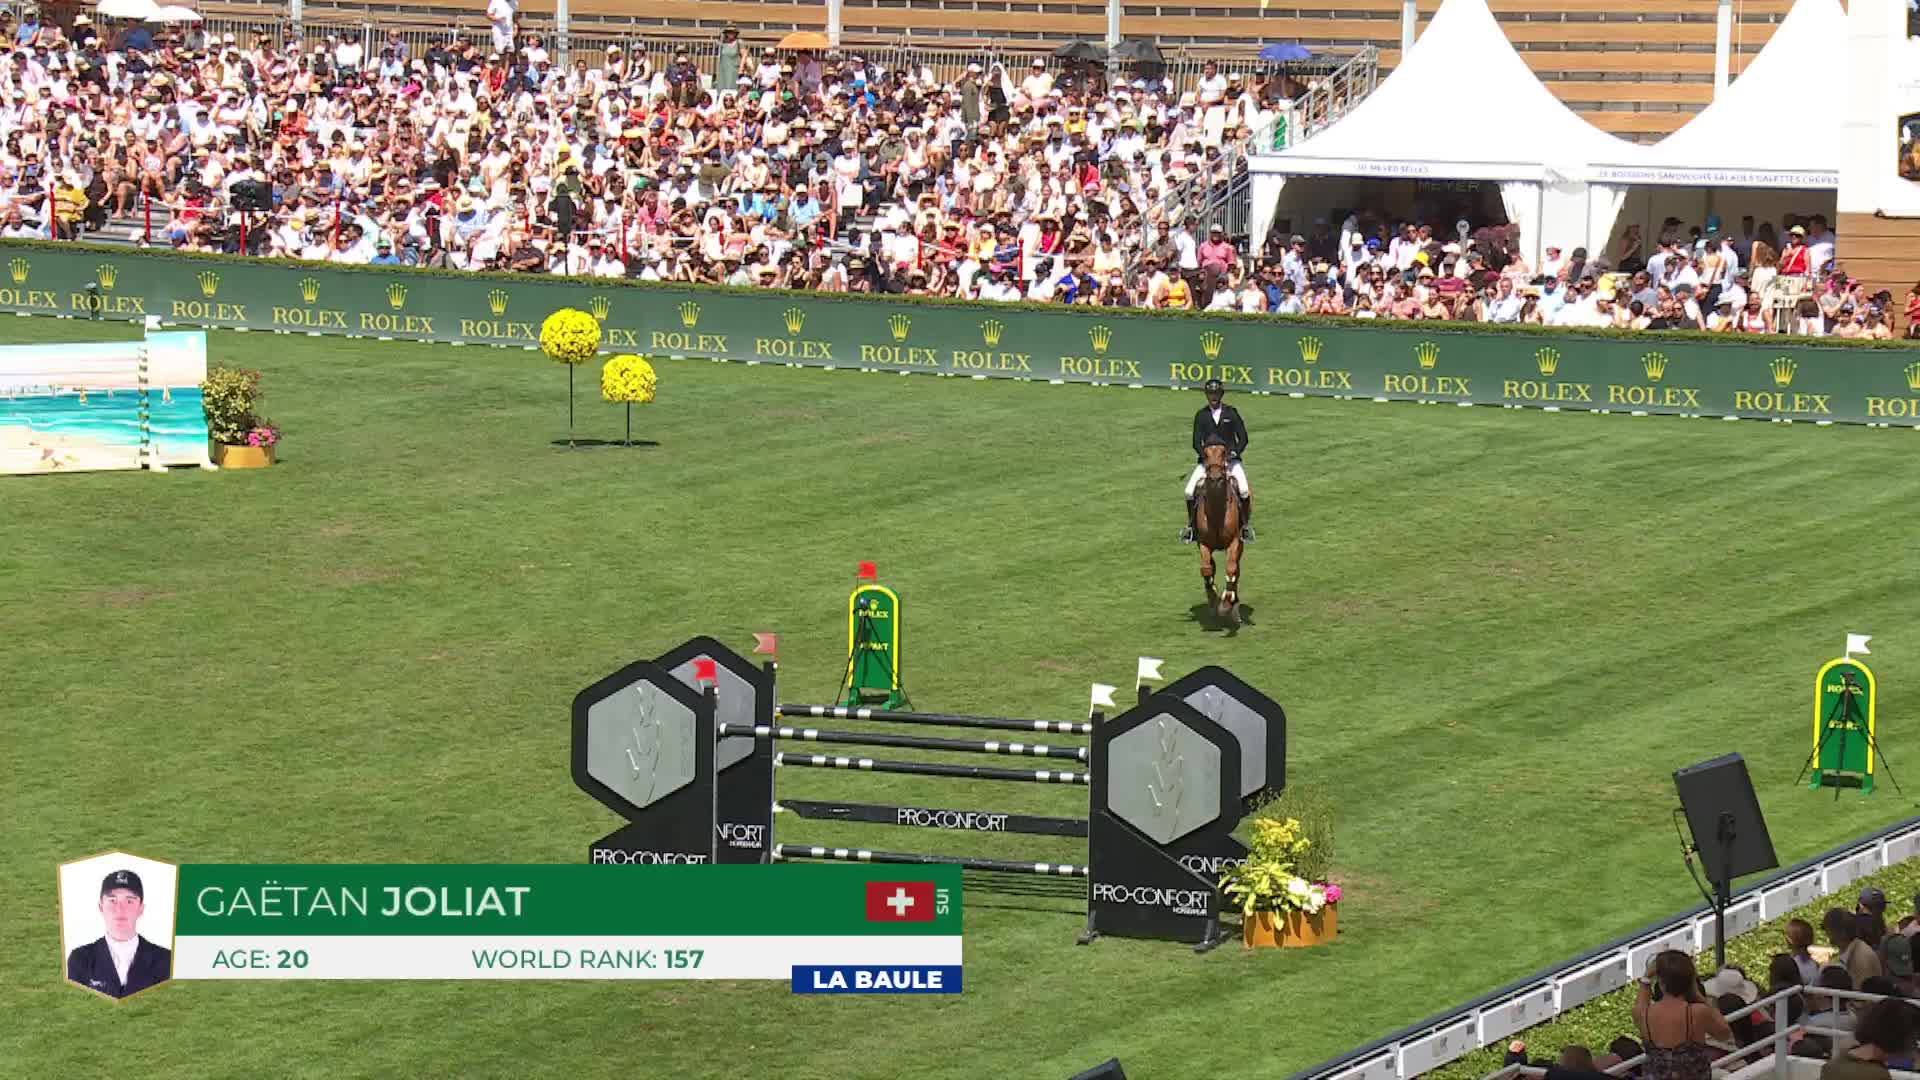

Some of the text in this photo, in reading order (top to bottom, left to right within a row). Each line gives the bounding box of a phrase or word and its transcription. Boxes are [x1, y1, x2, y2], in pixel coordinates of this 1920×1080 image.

[0, 289, 57, 308] OLEX
[71, 293, 145, 314] ROLEX
[172, 301, 247, 321] ROLEX
[273, 307, 347, 328] ROLEX
[359, 313, 434, 334] ROLEX
[461, 319, 535, 341] ROLEX
[652, 332, 728, 353] ROLEX
[756, 338, 833, 360] ROLEX
[860, 345, 939, 366] ROLEX
[952, 351, 1032, 372] ROLEX
[1060, 357, 1142, 378] ROLEX
[1170, 363, 1254, 385] ROLEX
[1268, 368, 1352, 390] ROLEX
[1383, 375, 1472, 396] ROLEX
[1503, 380, 1593, 403] ROLEX
[1607, 385, 1700, 407] ROLEX
[1734, 391, 1831, 414] ROLEX
[897, 808, 1008, 831] PRO-CONFORT
[1093, 882, 1211, 909] PRO-CONFORT
